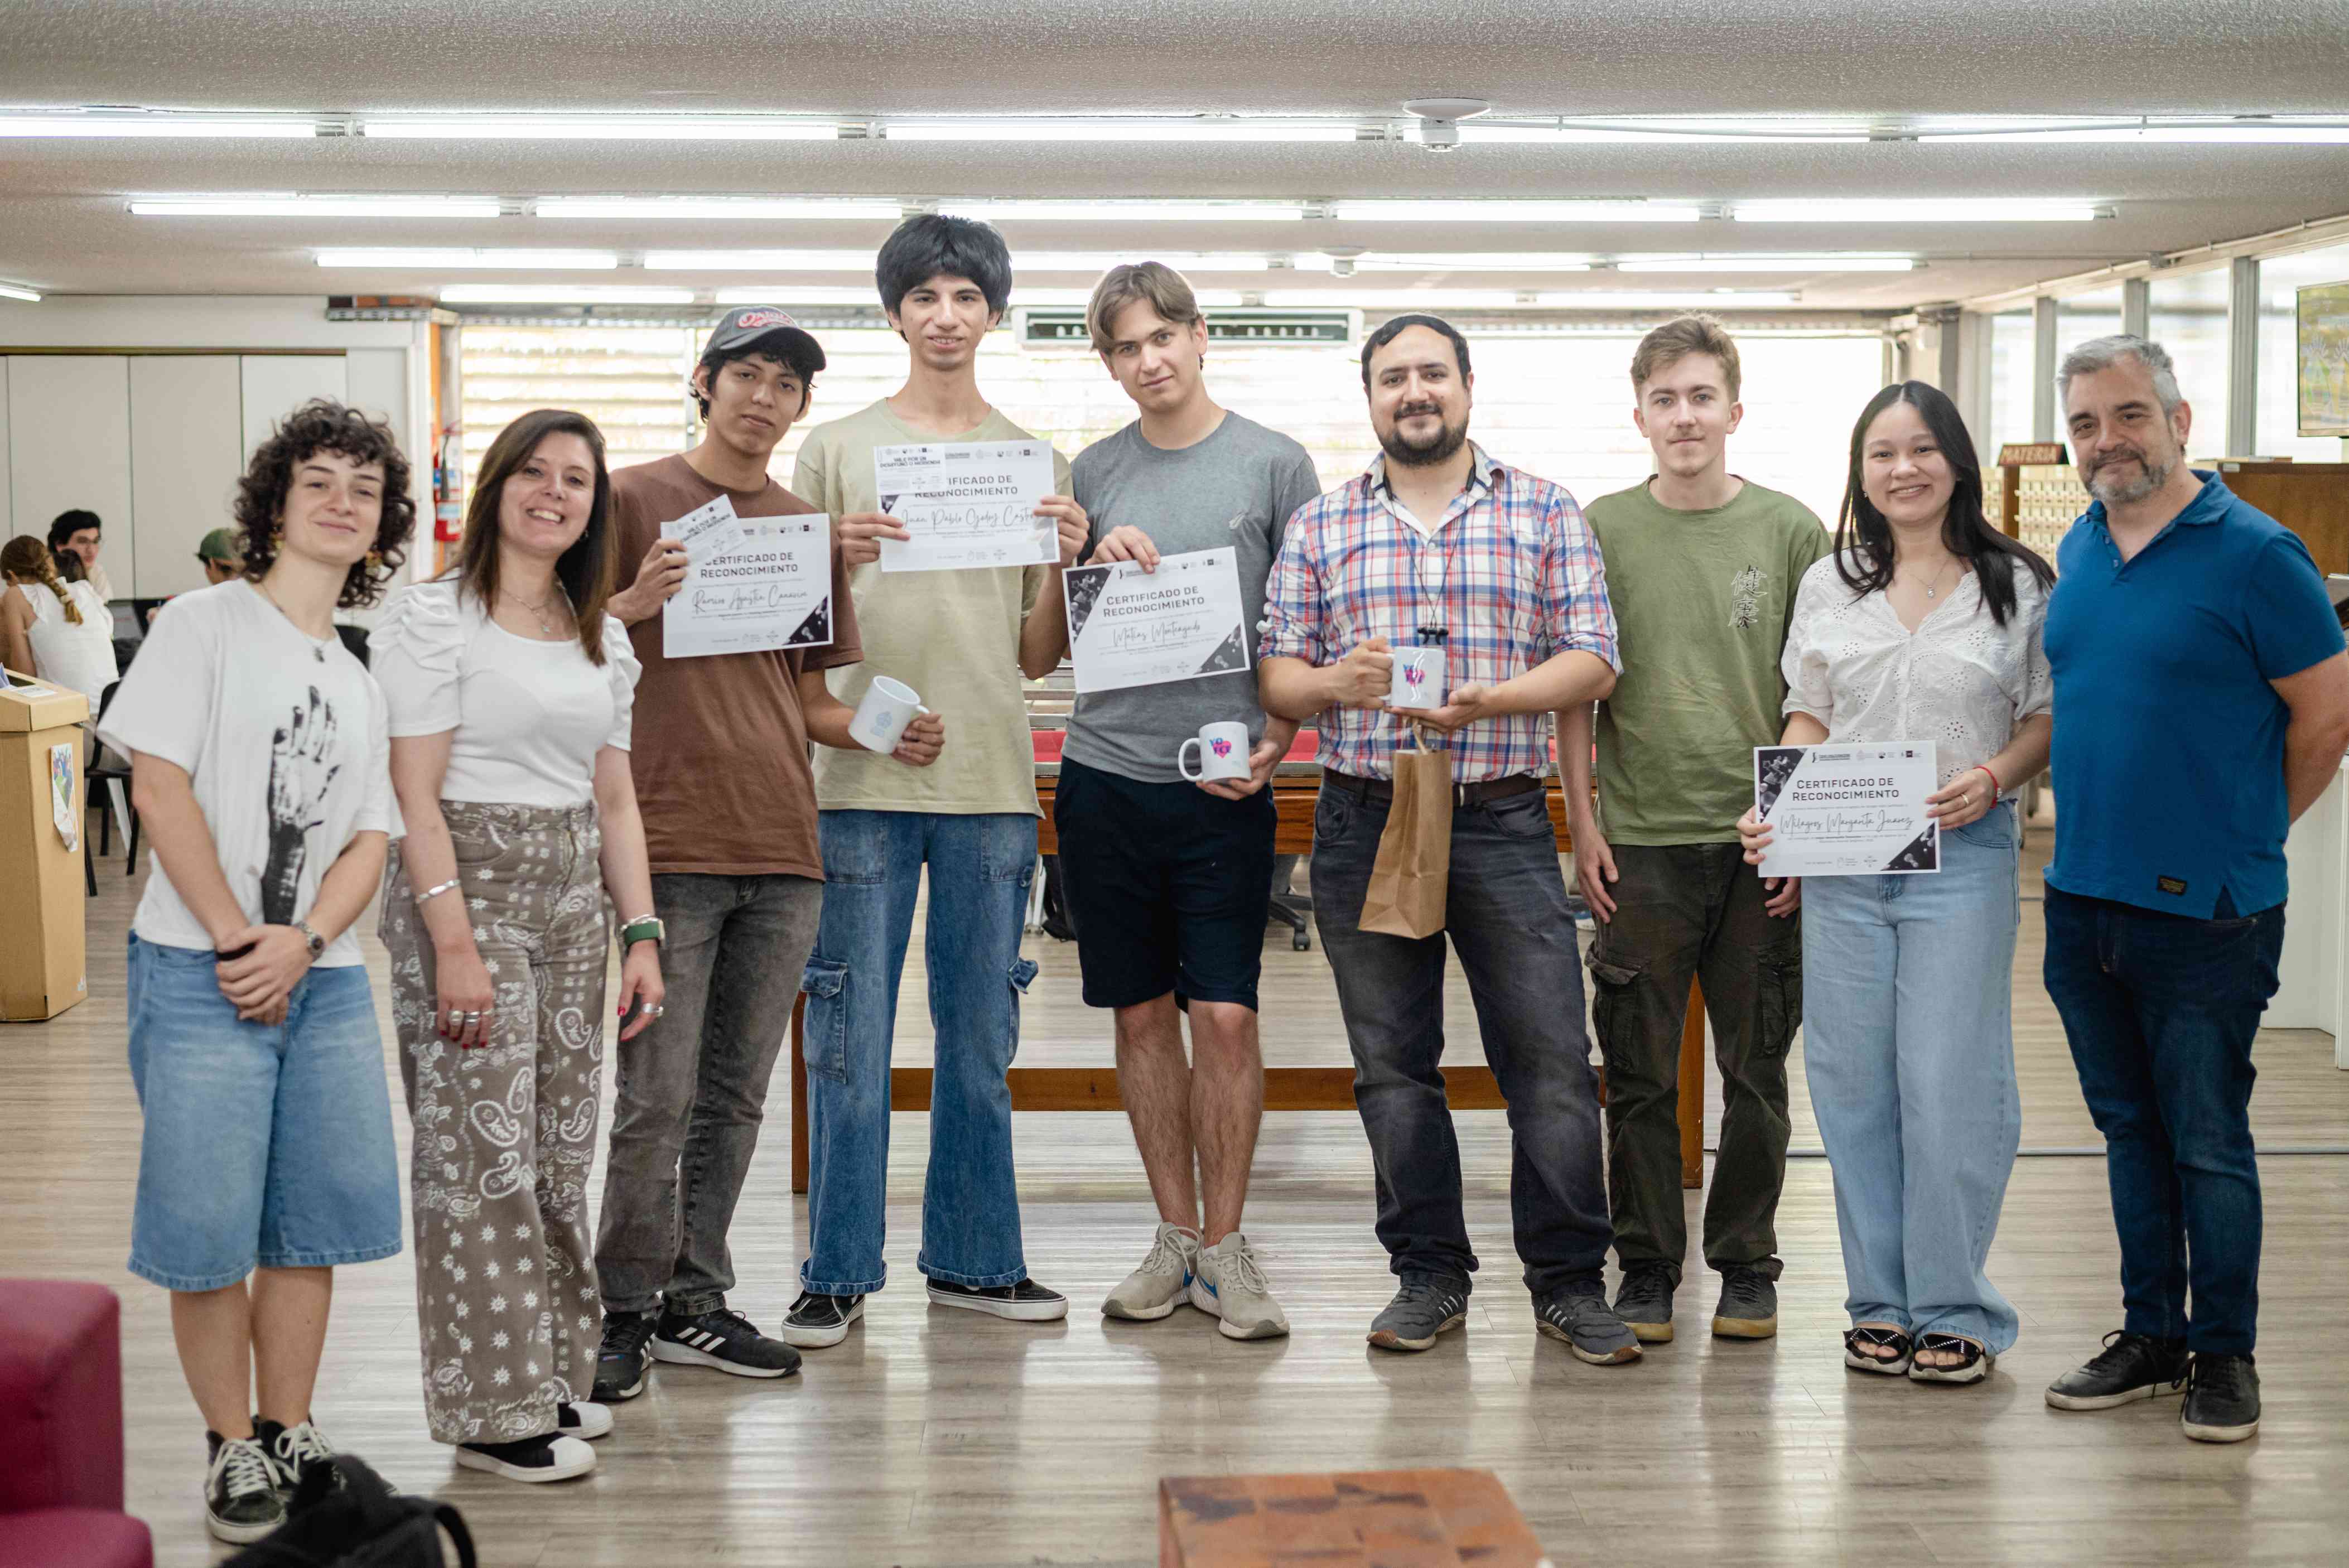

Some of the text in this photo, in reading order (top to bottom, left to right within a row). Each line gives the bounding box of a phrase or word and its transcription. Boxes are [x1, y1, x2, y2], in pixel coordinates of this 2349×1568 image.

[1999, 446, 2057, 464] MATERIA
[948, 475, 1012, 485] IFICADO DE
[780, 552, 794, 561] DE
[700, 563, 798, 578] RECONOCIMIENTO
[1106, 586, 1199, 606] CERTIFICADO DE
[1728, 565, 1768, 629] 健康
[1103, 597, 1205, 617] RECONOCIMIENTO
[1797, 778, 1894, 789] CERTIFICADO DE
[1792, 789, 1899, 802] RECONOCIMIENTO
[1780, 814, 1823, 836] Milagros
[1827, 813, 1874, 834] Margarita
